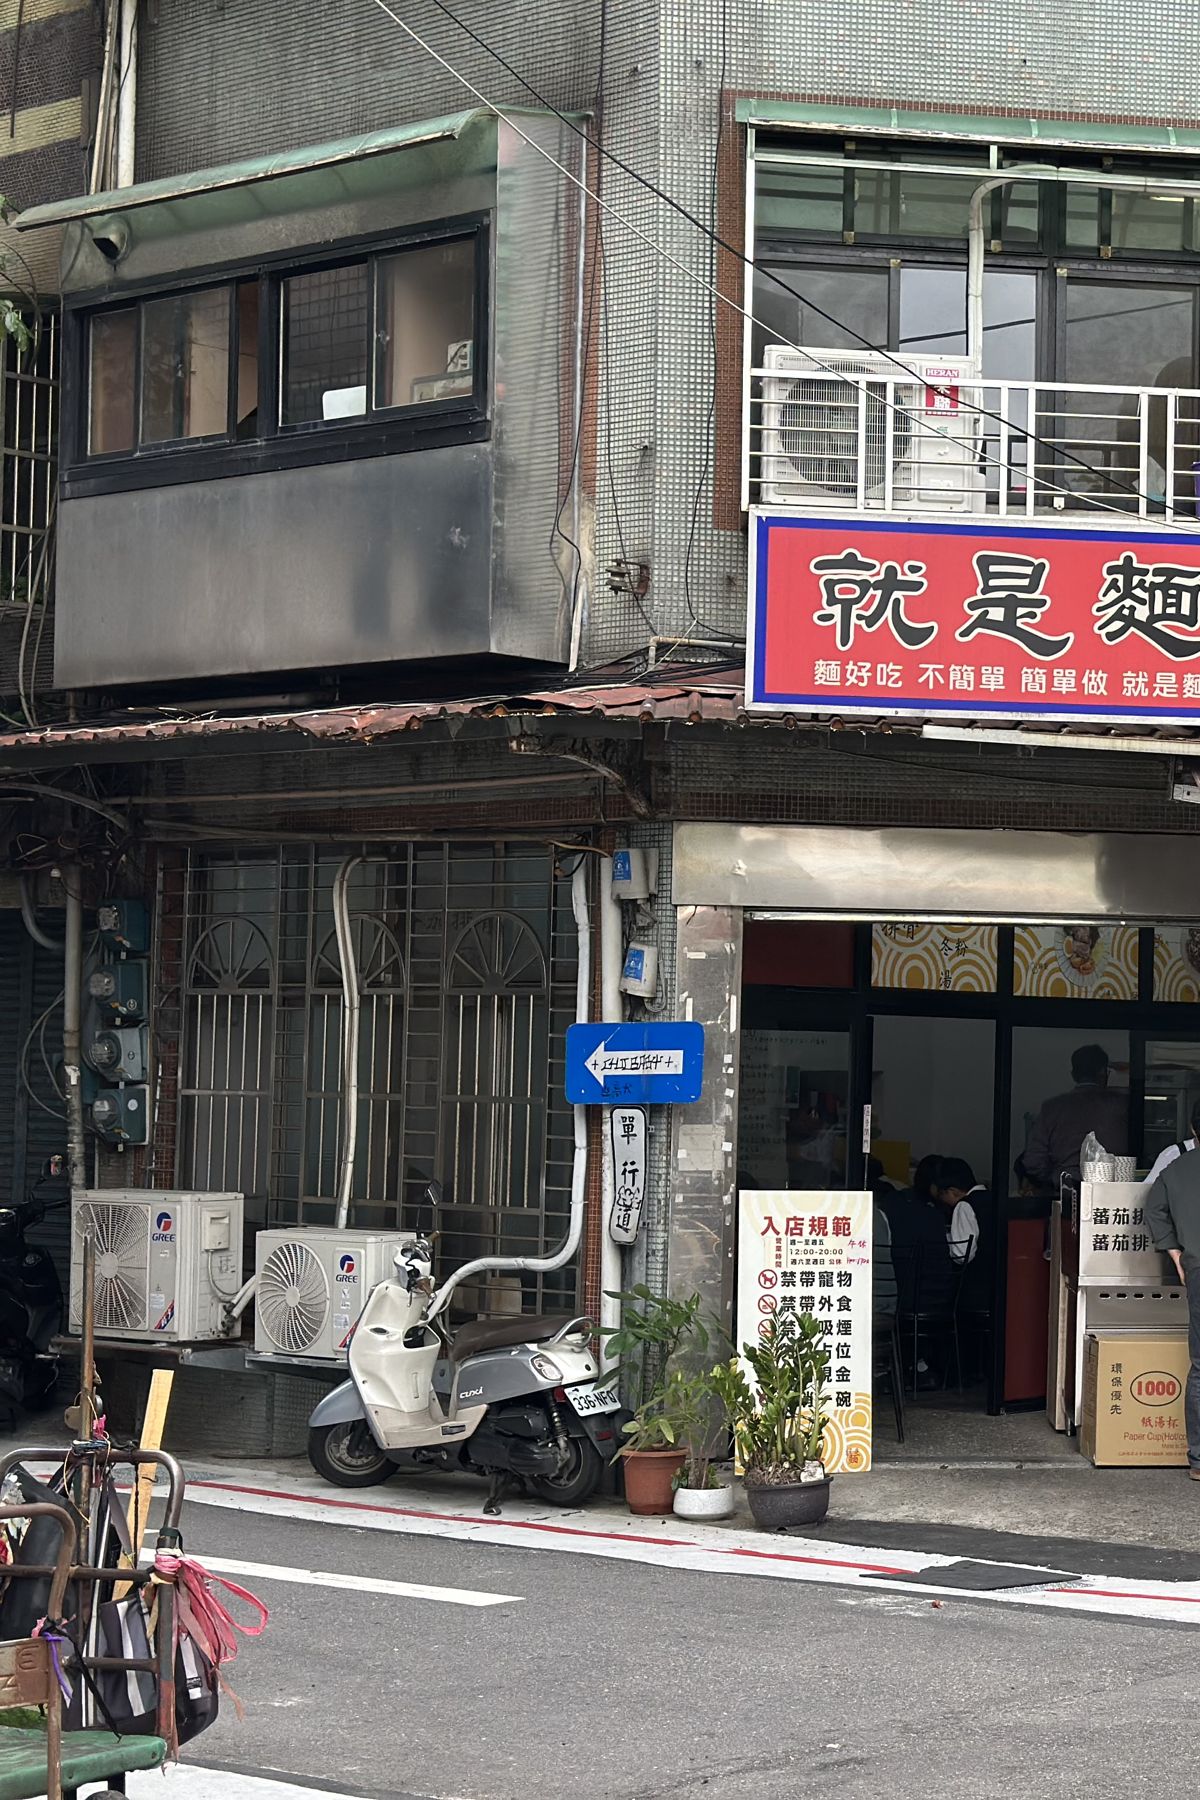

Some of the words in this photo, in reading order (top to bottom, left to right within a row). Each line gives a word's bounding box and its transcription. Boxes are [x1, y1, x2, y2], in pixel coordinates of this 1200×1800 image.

[926, 368, 959, 377] HERAN
[813, 658, 903, 689] 麵好吃
[918, 662, 1006, 692] 不簡單
[1021, 666, 1109, 697] 簡單做
[940, 935, 969, 957] 冬粉
[616, 1115, 639, 1233] 單行道
[760, 1215, 852, 1237] 入店規範
[152, 1233, 176, 1242] GREE
[1092, 1233, 1152, 1252] 蕃茄排
[335, 1274, 358, 1283] GREE
[780, 1270, 852, 1288] 禁帶寵物
[780, 1295, 852, 1313] 禁帶外食
[779, 1319, 852, 1336] 禁吸煙
[459, 1386, 483, 1399] cuxi
[1110, 1363, 1122, 1415] 環保優先
[1137, 1380, 1176, 1396] 1000
[1123, 1432, 1146, 1441] Paper
